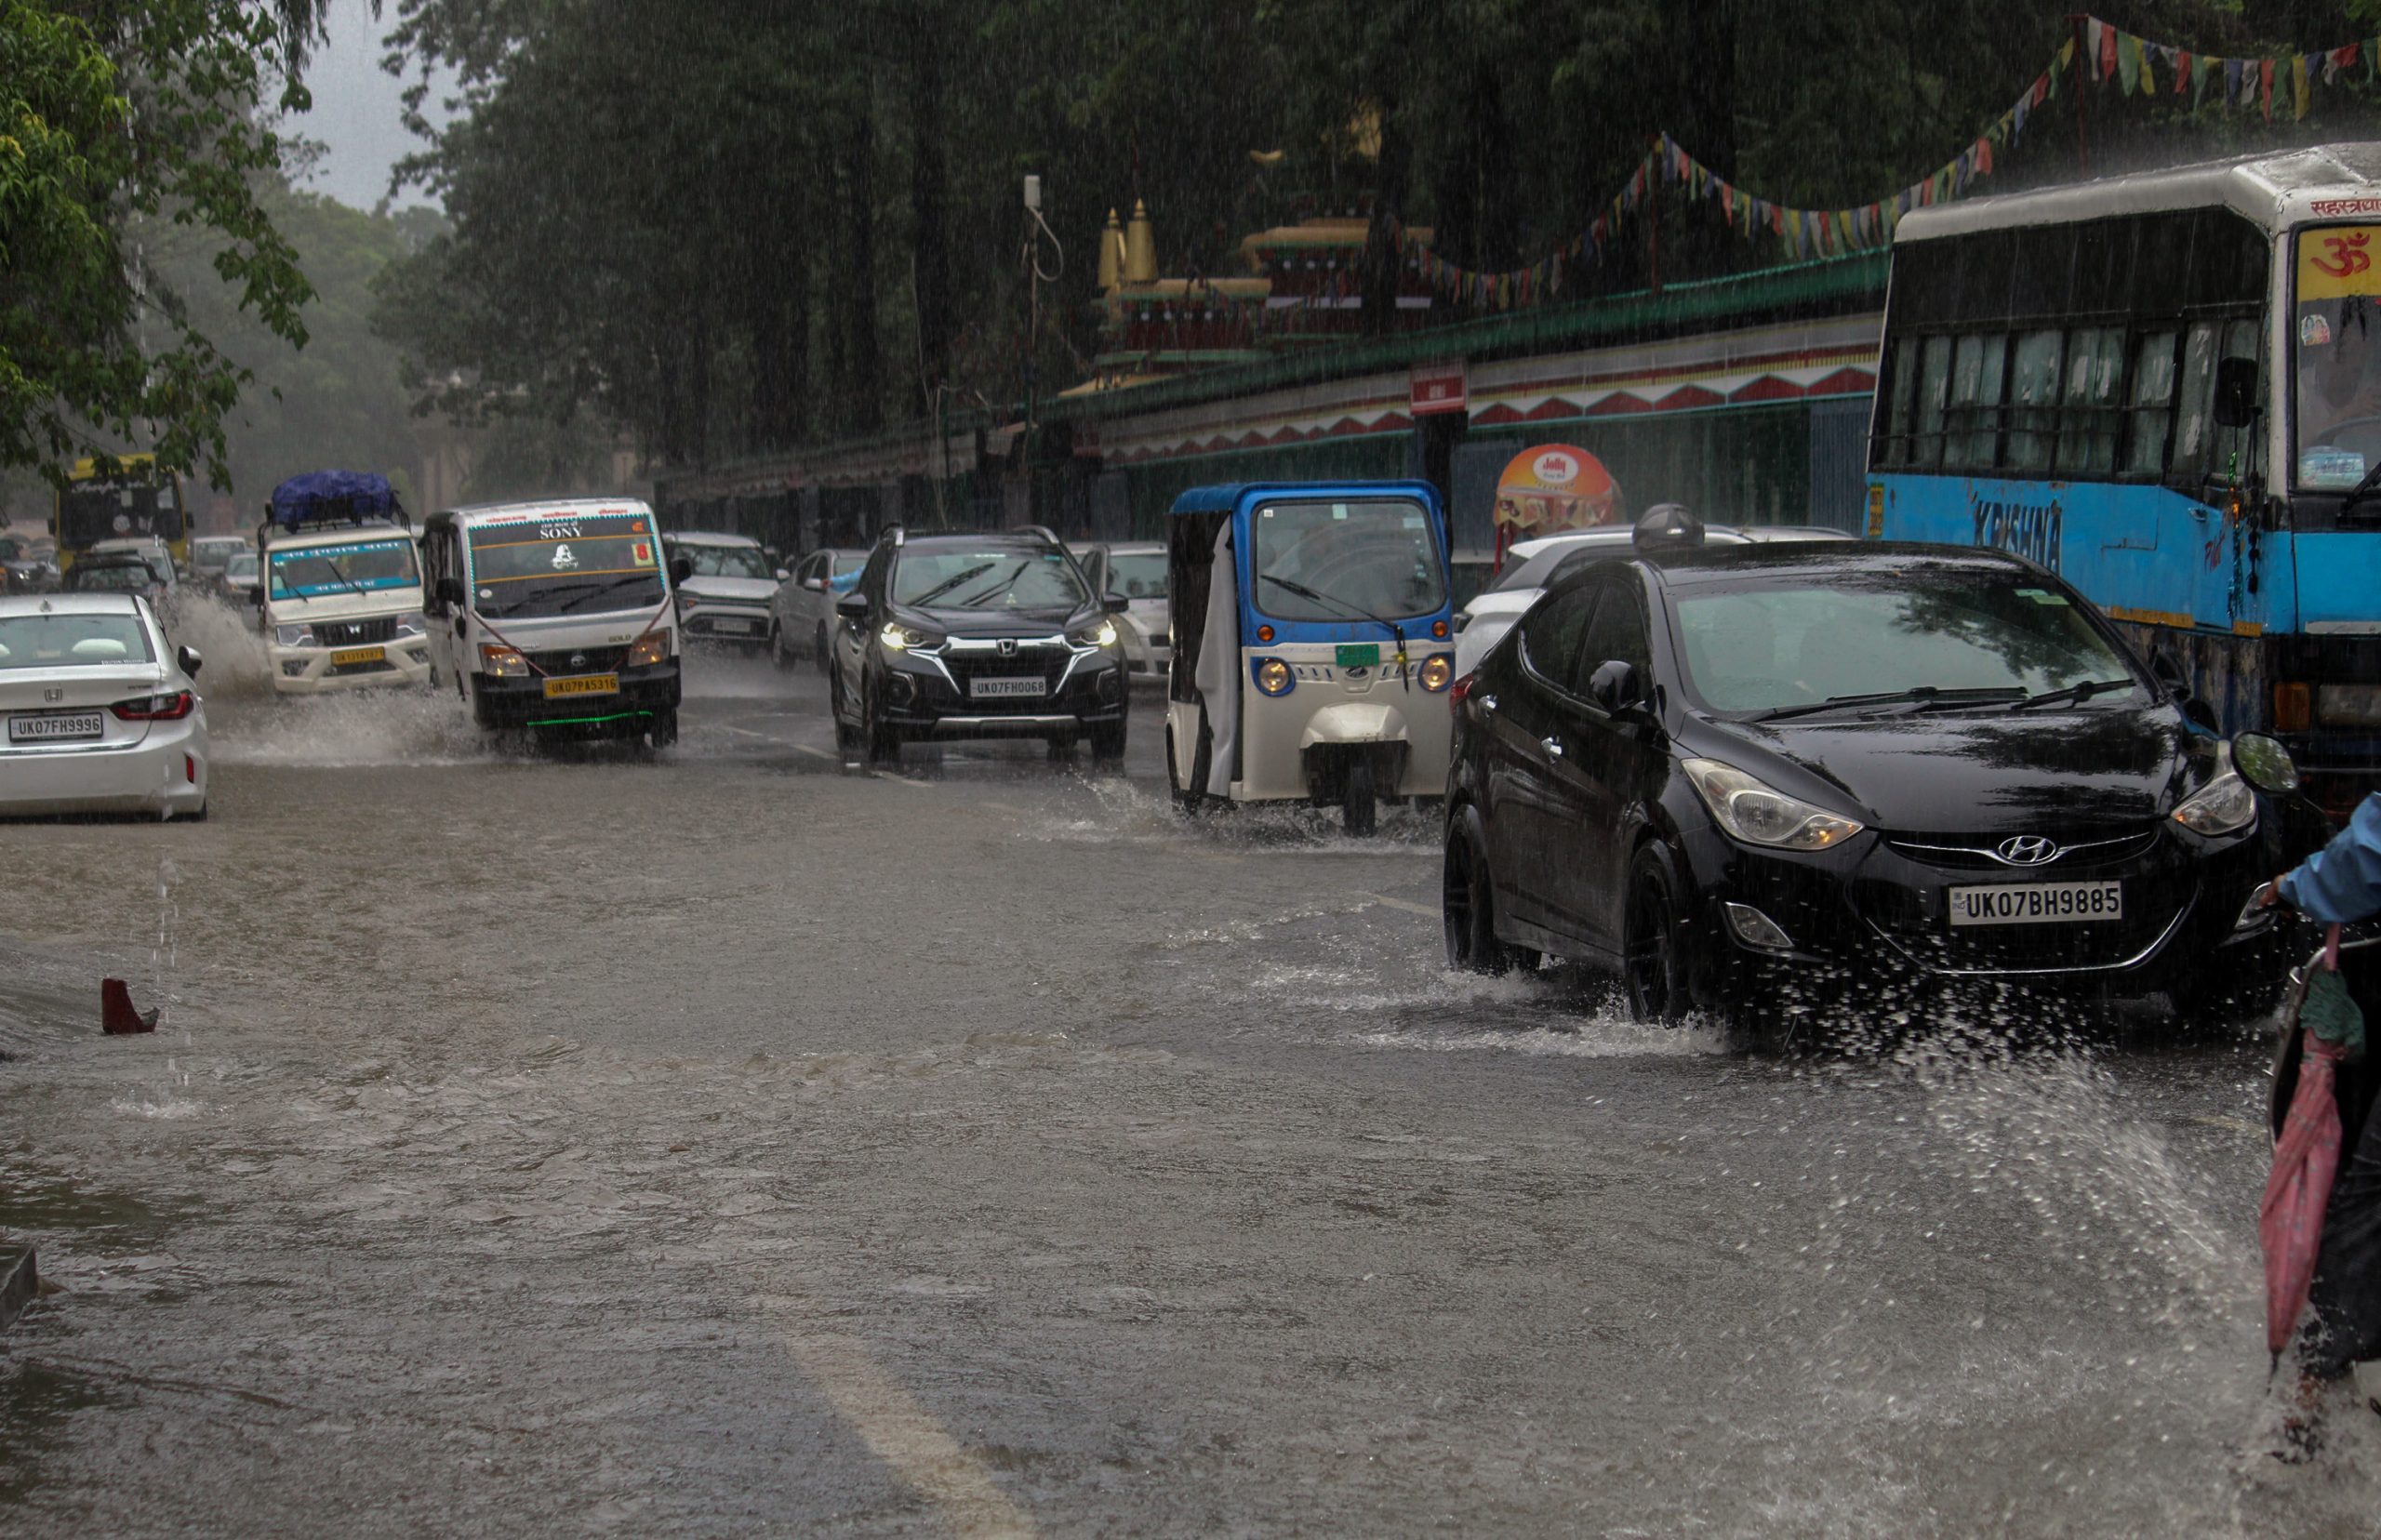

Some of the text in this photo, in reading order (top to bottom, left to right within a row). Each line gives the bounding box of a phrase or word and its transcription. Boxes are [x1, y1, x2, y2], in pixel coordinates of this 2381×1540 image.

[540, 526, 582, 539] SONY
[552, 678, 616, 694] UK07PA5316
[978, 682, 1044, 694] UK07FH0068
[19, 718, 100, 735] UK07FH9996
[1967, 888, 2119, 918] UK07BH9885
